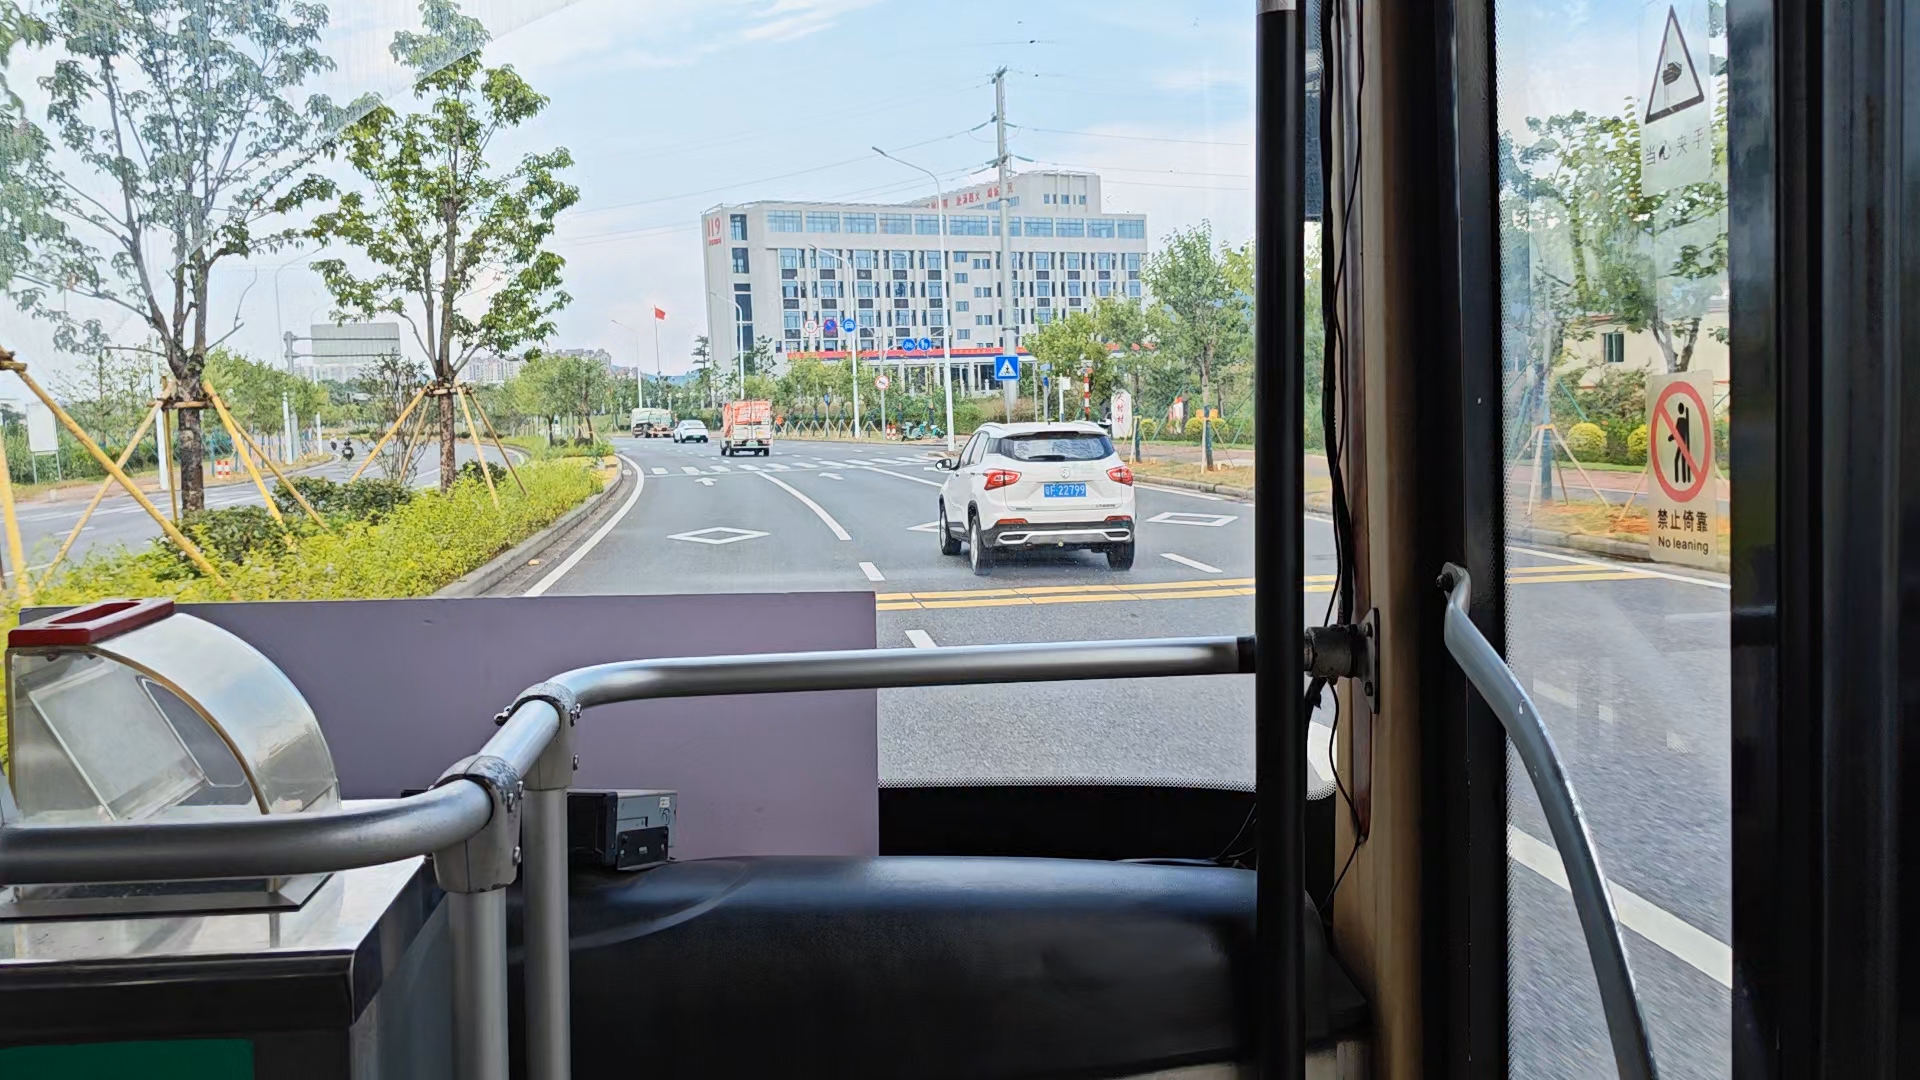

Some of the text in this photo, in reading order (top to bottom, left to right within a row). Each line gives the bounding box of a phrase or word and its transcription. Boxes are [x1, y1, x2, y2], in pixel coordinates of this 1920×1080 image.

[1645, 127, 1705, 167] 当心夹手
[707, 217, 721, 237] 119
[1657, 508, 1708, 532] 禁止倚靠
[1658, 535, 1709, 555] No leaning
